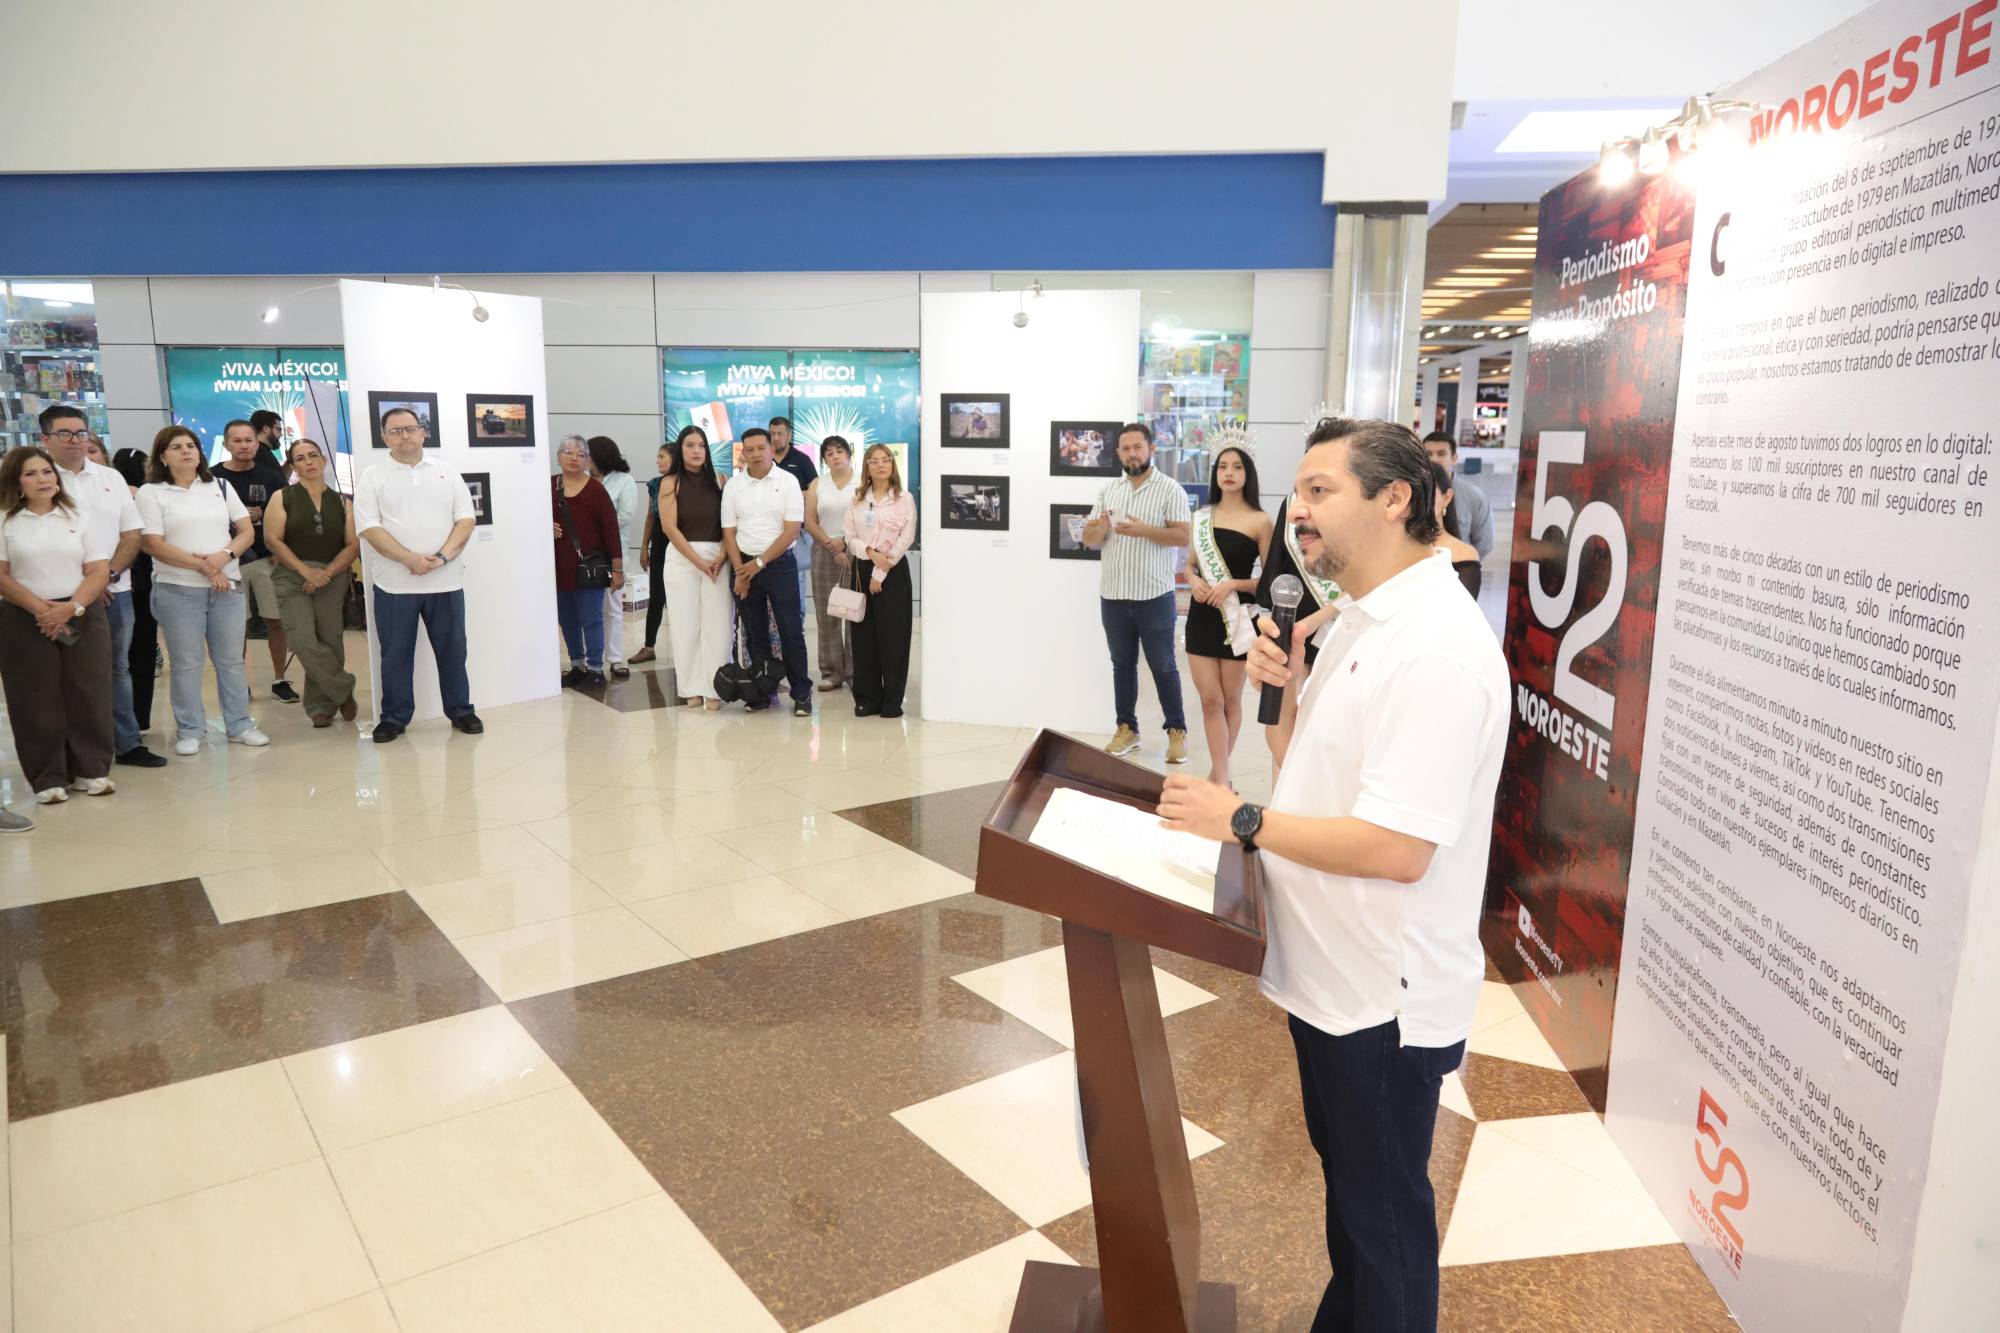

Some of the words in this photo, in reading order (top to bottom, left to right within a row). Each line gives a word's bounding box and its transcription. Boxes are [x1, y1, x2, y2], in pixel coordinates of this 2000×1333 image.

[1831, 169, 1849, 192] del
[1850, 167, 1859, 186] 8
[1861, 161, 1876, 182] de
[1878, 137, 1950, 177] septiembre
[1953, 126, 1972, 150] de
[1801, 203, 1839, 228] octubre
[1839, 195, 1855, 216] de
[1856, 185, 1884, 211] 1979
[1884, 184, 1899, 202] en
[1900, 162, 1963, 197] Mazatlán,
[1811, 220, 1853, 249] editorial
[1856, 203, 1925, 242] periodístico
[1833, 253, 1847, 270] en
[1848, 247, 1860, 266] lo
[1861, 235, 1898, 265] digital
[1899, 238, 1908, 254] e
[1909, 224, 1965, 253] impreso.
[1560, 234, 1649, 289] Periodismo
[1576, 278, 1656, 322] Propósito
[1807, 306, 1817, 325] el
[1819, 305, 1847, 324] buen
[1849, 293, 1919, 323] periodismo,
[1924, 276, 1989, 307] realizado
[1800, 358, 1843, 377] estamos
[1844, 350, 1894, 372] tratando
[1896, 348, 1913, 368] de
[1915, 342, 1989, 366] demostrar
[1805, 336, 1824, 351] con
[1824, 324, 1873, 349] seriedad,
[1874, 318, 1915, 347] podría
[1916, 314, 1979, 342] pensarse
[213, 379, 261, 393] ¡VIVAN
[263, 379, 292, 392] LOS
[221, 361, 266, 377] ¡VIVA
[268, 358, 339, 376] MÉXICO!
[716, 383, 770, 398] ¡VIVAN
[773, 384, 803, 397] LOS
[727, 364, 776, 382] ¡VIVA
[780, 361, 856, 381] MÉXICO!
[1730, 455, 1744, 471] los
[1747, 455, 1763, 473] 100
[1766, 456, 1782, 473] mil
[1784, 458, 1844, 480] suscriptores
[1849, 464, 1864, 479] en
[1869, 463, 1917, 482] nuestro
[1923, 463, 1961, 484] canal
[1967, 463, 1988, 486] de
[1736, 437, 1753, 449] mes
[1754, 432, 1766, 449] de
[1767, 435, 1798, 453] agosto
[1800, 433, 1841, 451] tuvimos
[1842, 432, 1863, 452] dos
[1865, 432, 1903, 457] logros
[1905, 438, 1922, 453] en
[1925, 432, 1939, 454] lo
[1942, 432, 1993, 459] digital:
[1729, 481, 1775, 497] superamos
[1778, 480, 1788, 498] la
[1791, 482, 1812, 501] cifra
[1816, 483, 1831, 502] de
[1835, 486, 1856, 505] 700
[1861, 487, 1881, 507] mil
[1885, 491, 1957, 516] seguidores
[1964, 500, 1983, 517] en
[1528, 431, 1628, 731] 52
[1804, 562, 1823, 579] con
[1826, 567, 1840, 582] un
[1843, 568, 1873, 589] estilo
[1876, 572, 1892, 593] de
[1895, 580, 1970, 610] periodismo
[1808, 609, 1828, 632] Nos
[1829, 615, 1843, 636] ha
[1845, 619, 1910, 655] funcionado
[1912, 643, 1961, 670] porque
[1811, 585, 1848, 613] basura,
[1855, 597, 1880, 618] sólo
[1888, 603, 1965, 640] información
[1783, 654, 1811, 677] través
[1811, 663, 1825, 682] de
[1826, 666, 1842, 688] los
[1842, 677, 1877, 701] cuales
[1878, 685, 1956, 729] informamos.
[1785, 629, 1811, 652] único
[1812, 641, 1832, 660] que
[1832, 642, 1869, 671] hemos
[1870, 659, 1930, 690] cambiado
[1932, 678, 1957, 698] son
[1518, 683, 1611, 783] NOROESTE
[1850, 735, 1894, 764] nuestro
[1896, 751, 1924, 777] sitio
[1926, 767, 1943, 785] en
[1826, 771, 1873, 812] YouTube.
[1880, 798, 1935, 843] Tenemos
[1838, 756, 1853, 774] en
[1855, 764, 1887, 790] redes
[1889, 780, 1940, 815] sociales
[1826, 800, 1846, 825] dos
[1848, 812, 1931, 871] transmisiones
[1809, 842, 1844, 878] interés
[1848, 871, 1923, 927] periodístico.
[1841, 835, 1856, 858] de
[1860, 850, 1927, 899] constantes
[1809, 868, 1857, 913] impresos
[1859, 902, 1899, 941] diarios
[1902, 933, 1919, 954] en
[1819, 959, 1839, 982] nos
[1842, 976, 1907, 1035] adaptamos
[1812, 1006, 1831, 1030] con
[1832, 1017, 1842, 1040] la
[1843, 1031, 1899, 1087] veracidad
[1847, 1008, 1903, 1060] continuar
[1798, 1098, 1827, 1134] sobre
[1828, 1125, 1855, 1162] todo
[1857, 1155, 1873, 1179] de
[1874, 1173, 1883, 1191] y
[1804, 1073, 1831, 1111] igual
[1833, 1105, 1855, 1135] que
[1858, 1123, 1886, 1165] hace
[1695, 1087, 1749, 1253] 52
[1789, 1114, 1811, 1144] ellas
[1812, 1137, 1866, 1202] validamos
[1867, 1196, 1880, 1215] el
[1789, 1140, 1832, 1194] nuestros
[1833, 1181, 1879, 1245] lectores.
[1688, 1188, 1743, 1271] NOROESTE
